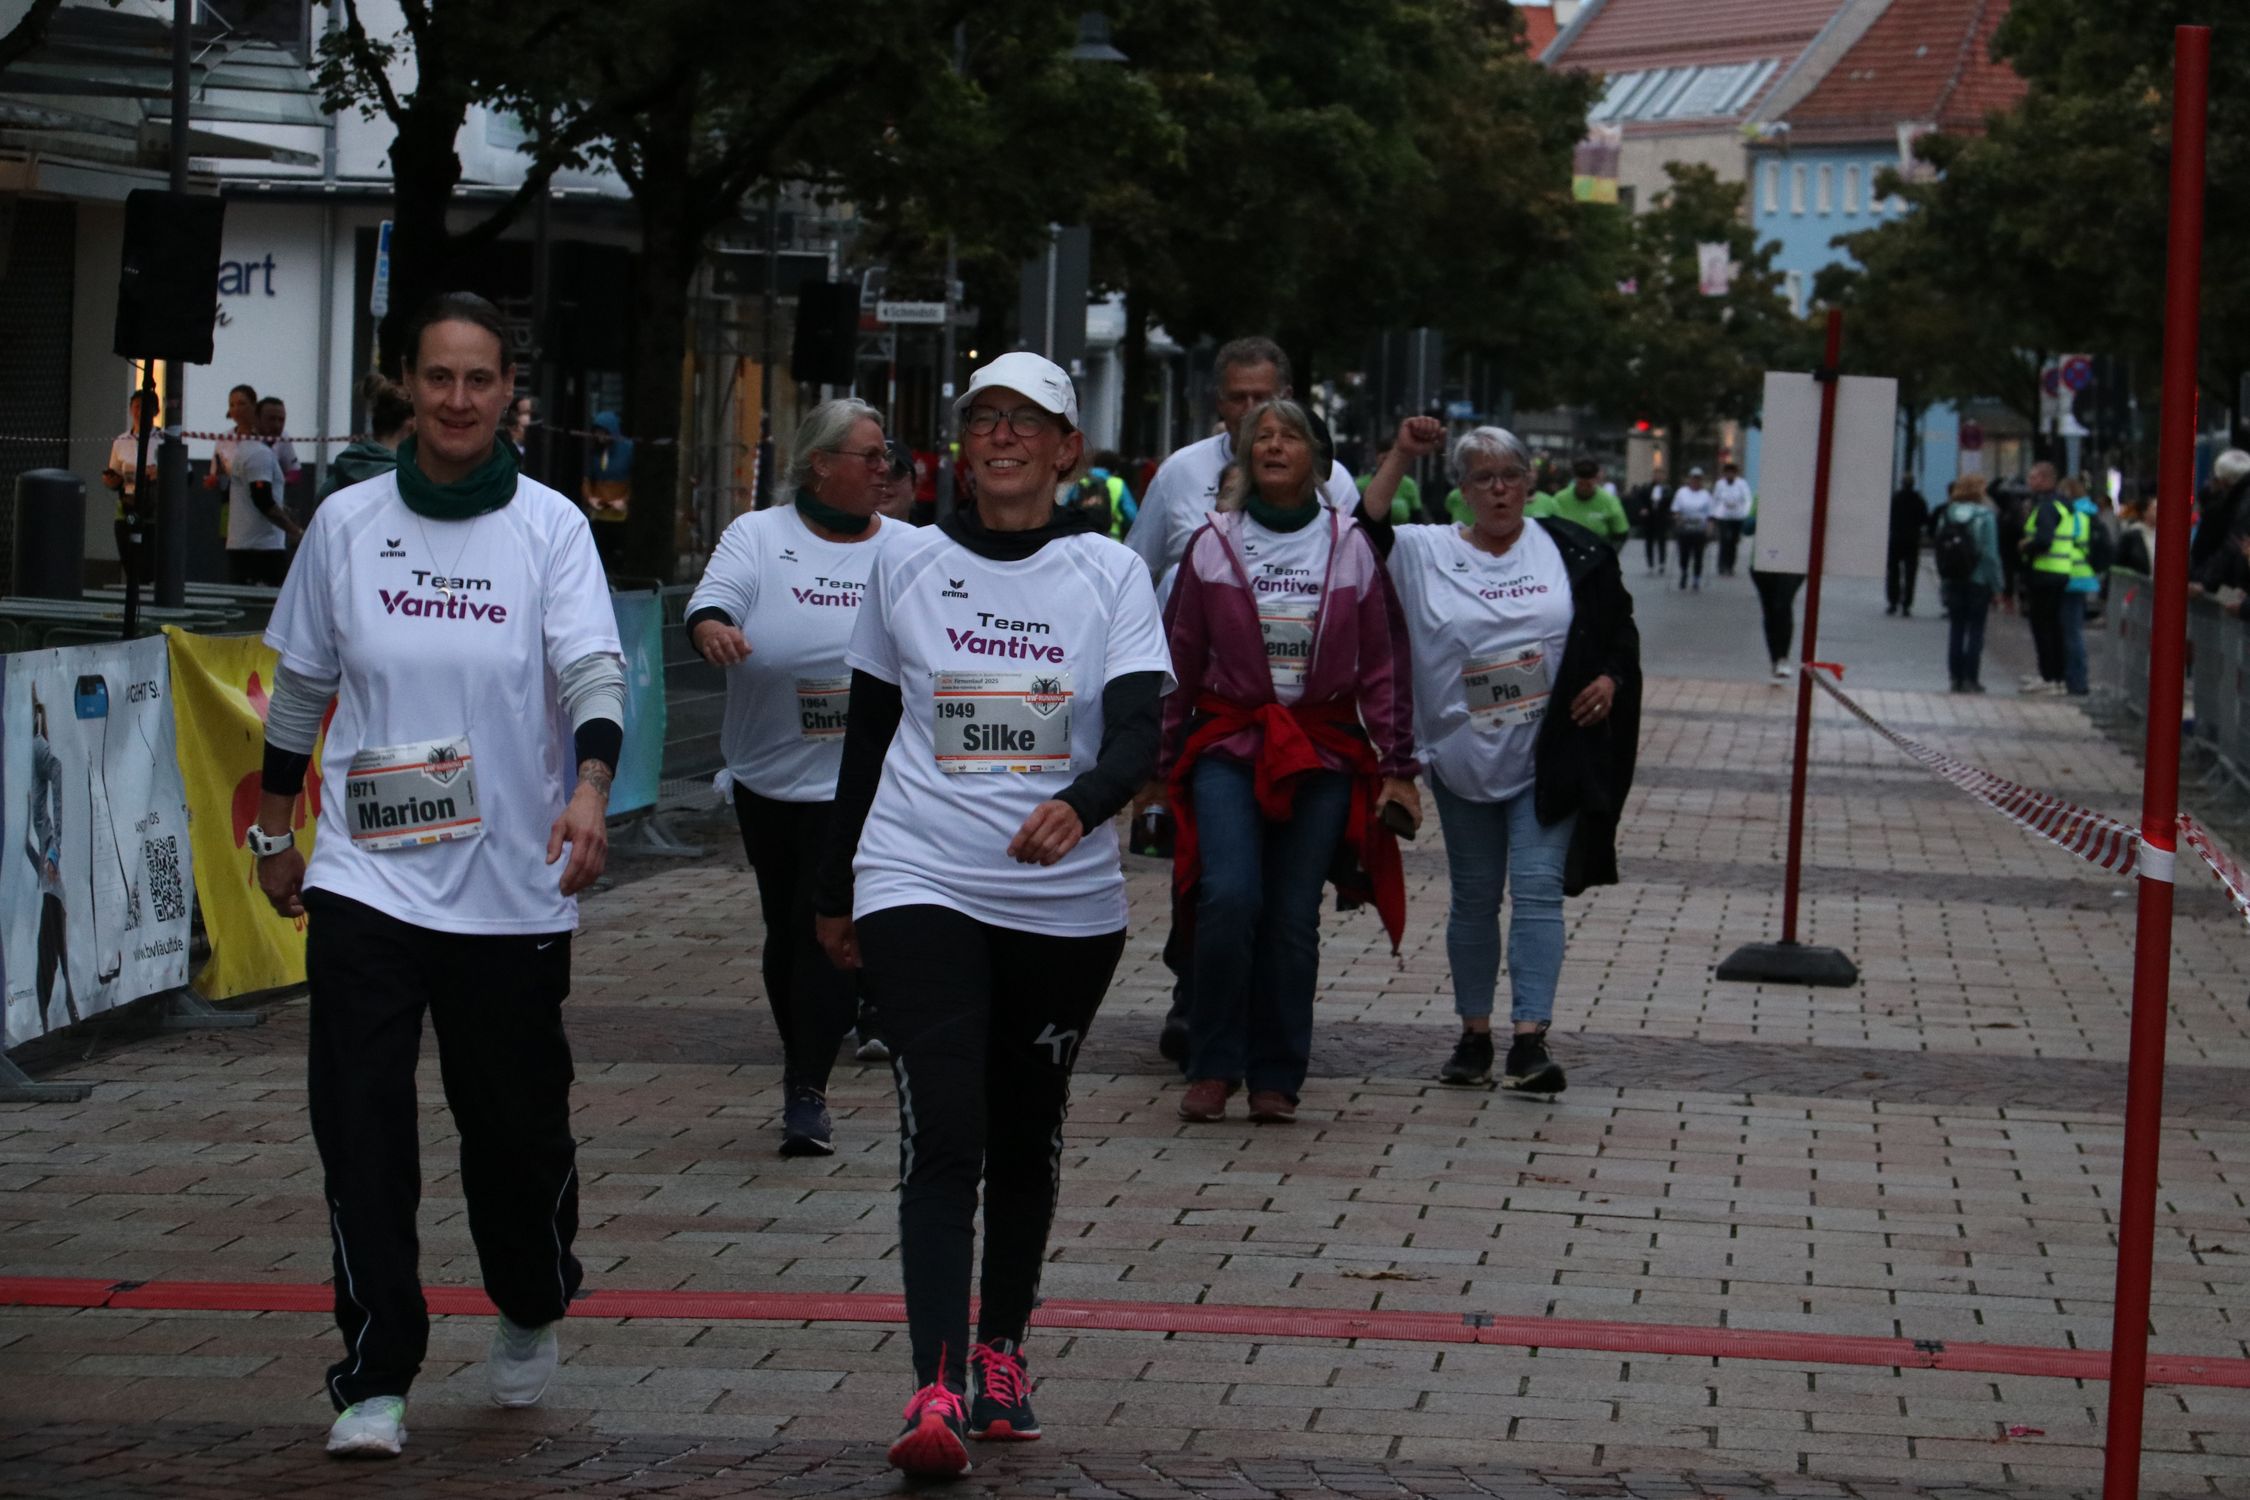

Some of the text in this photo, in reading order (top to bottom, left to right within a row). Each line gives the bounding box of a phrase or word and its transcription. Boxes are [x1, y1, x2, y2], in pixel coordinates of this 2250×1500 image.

[218, 253, 276, 296] art
[412, 570, 491, 590] Team
[1263, 564, 1310, 576] Team
[942, 590, 969, 599] erima
[378, 589, 507, 623] Vantive
[977, 612, 1050, 634] Team
[946, 627, 1064, 663] Vantive
[1491, 683, 1521, 702] Pia
[800, 698, 828, 708] 1964
[936, 702, 975, 718] 1949
[963, 724, 1035, 751] Silke
[346, 781, 377, 798] 1971
[358, 797, 456, 830] Marion
